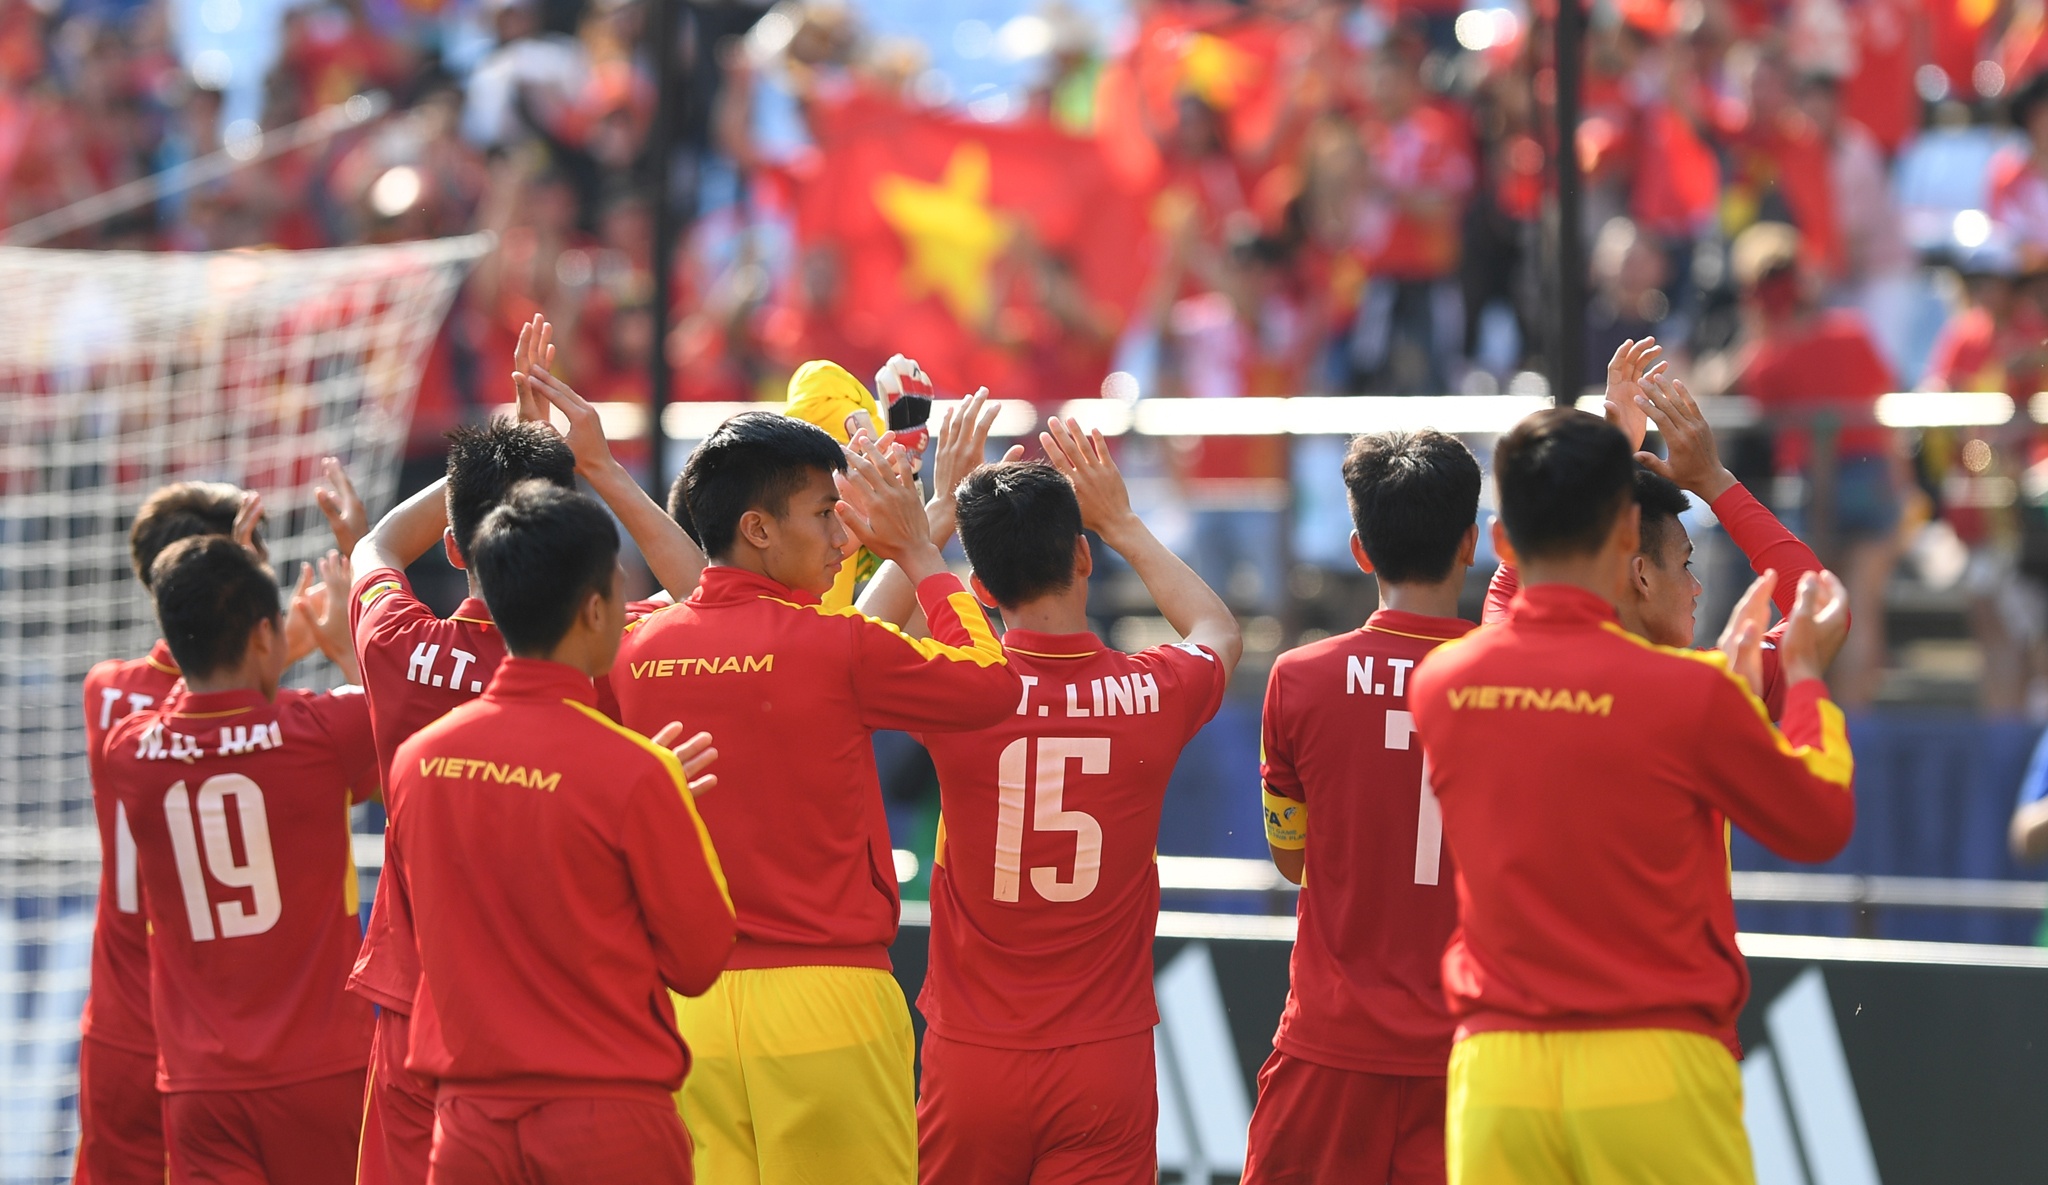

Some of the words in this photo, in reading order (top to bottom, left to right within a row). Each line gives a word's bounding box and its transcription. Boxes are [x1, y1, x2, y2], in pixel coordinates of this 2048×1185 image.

[406, 641, 483, 693] H.T.
[630, 653, 774, 681] VIETNAM
[1065, 672, 1160, 718] LINH
[1446, 686, 1614, 717] VIETNAM
[419, 756, 562, 793] VIETNAM
[993, 737, 1111, 903] 15
[164, 773, 282, 942] 19
